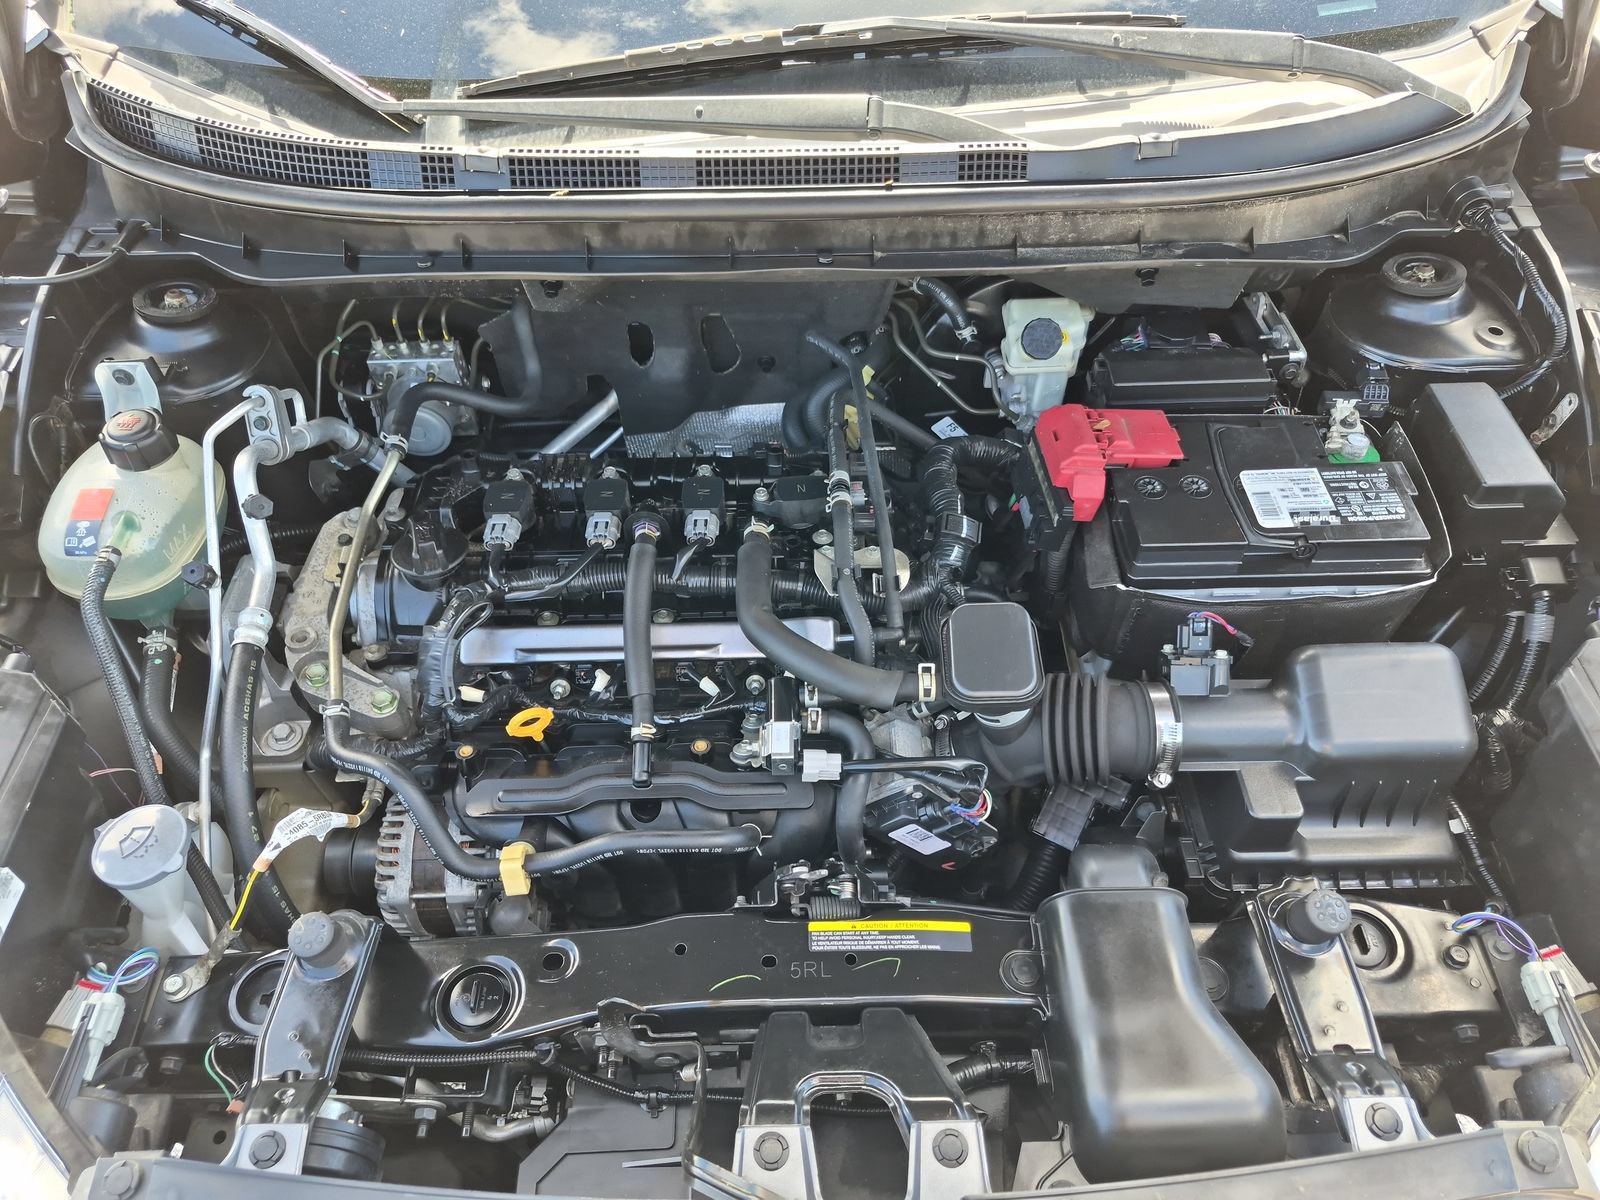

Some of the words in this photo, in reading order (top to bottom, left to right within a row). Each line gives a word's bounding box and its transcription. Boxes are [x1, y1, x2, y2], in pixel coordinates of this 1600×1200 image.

[946, 422, 959, 432] F5
[797, 484, 806, 493] N
[1293, 514, 1338, 523] Duralast
[790, 961, 832, 979] 5RL
